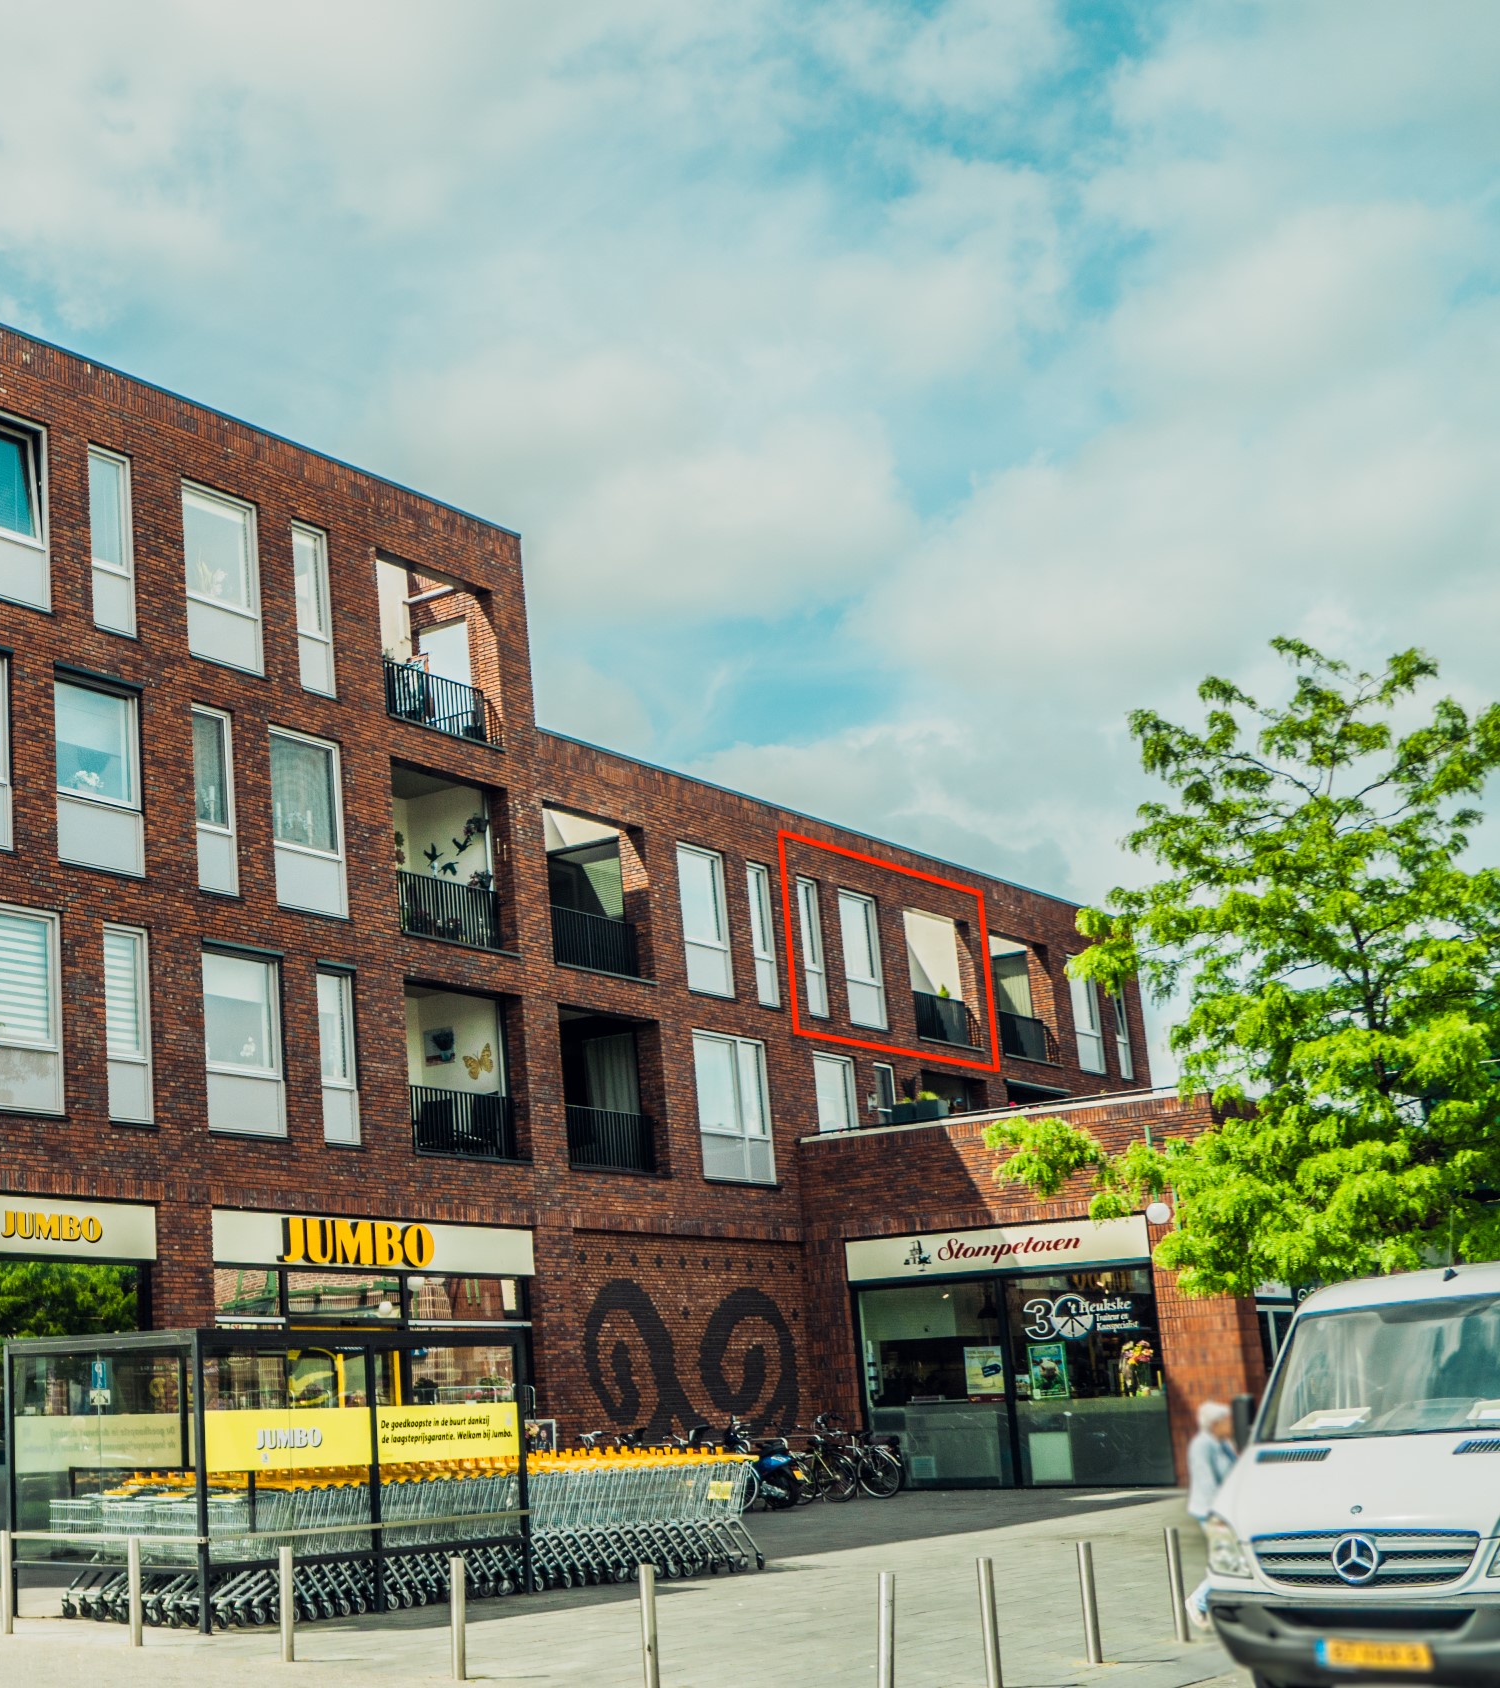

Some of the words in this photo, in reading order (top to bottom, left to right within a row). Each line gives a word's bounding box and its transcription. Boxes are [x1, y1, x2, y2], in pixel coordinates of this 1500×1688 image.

[1, 1210, 103, 1243] JUMBO
[277, 1217, 435, 1269] JUMBO
[938, 1237, 1082, 1264] Stompetoren
[1079, 1297, 1132, 1314] Heukske
[381, 1420, 390, 1429] De
[391, 1419, 432, 1431] goedkoopste
[433, 1417, 440, 1427] in
[441, 1417, 448, 1427] de
[449, 1417, 466, 1426] buurt
[468, 1415, 490, 1427] dankzij
[256, 1427, 323, 1450] JUMBO
[381, 1435, 390, 1444] de
[457, 1430, 482, 1440] Welkom
[482, 1429, 491, 1441] bij
